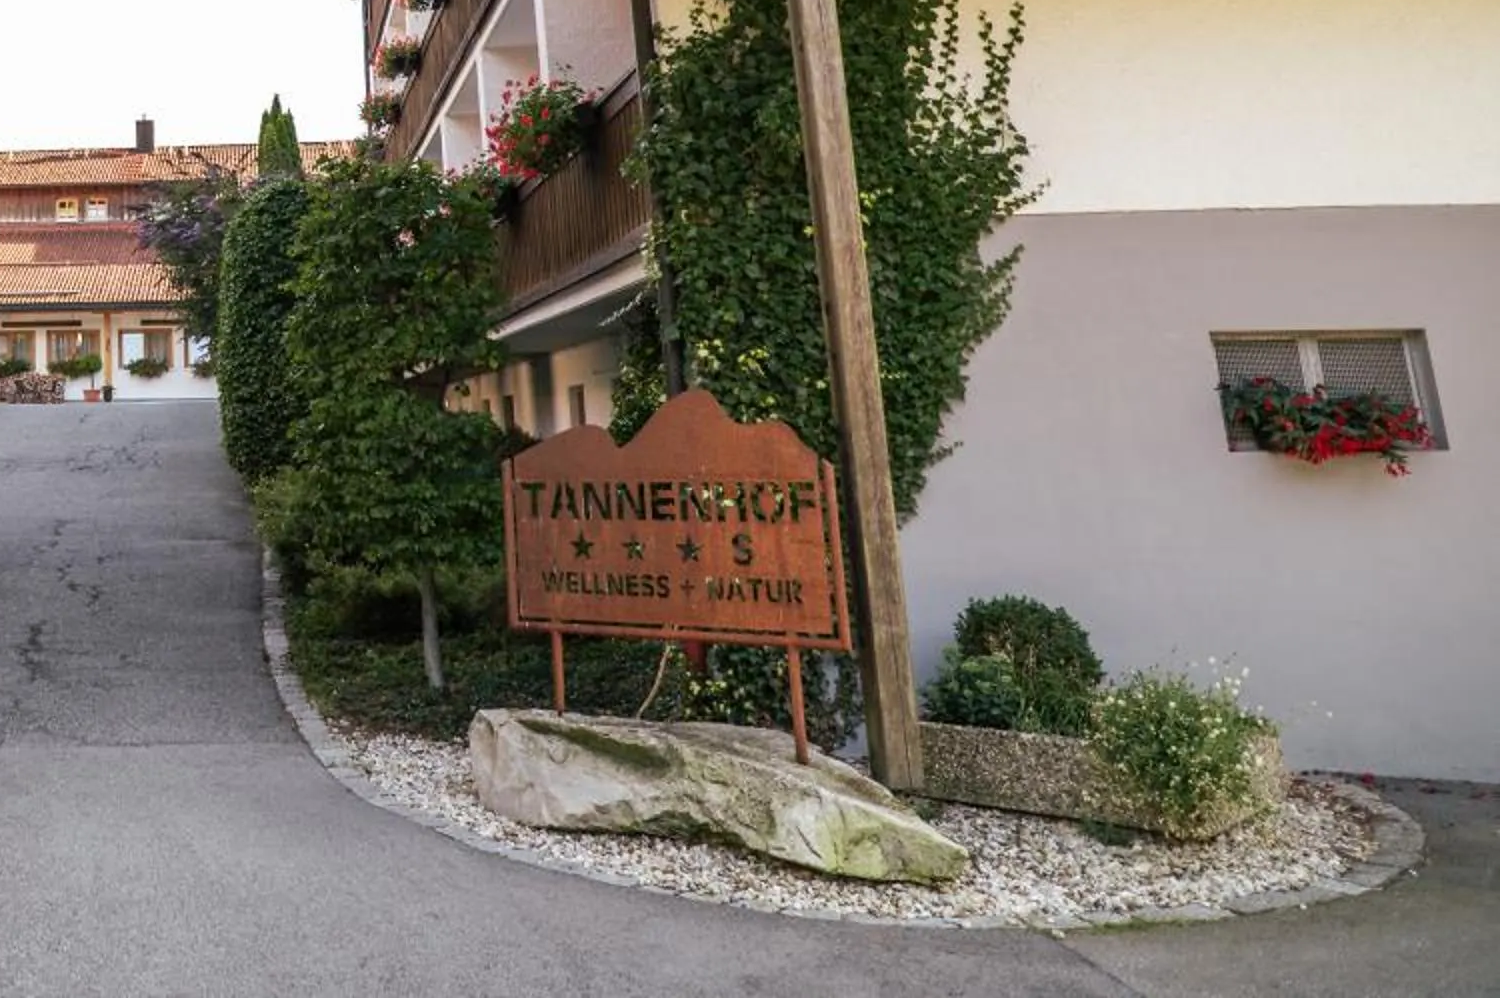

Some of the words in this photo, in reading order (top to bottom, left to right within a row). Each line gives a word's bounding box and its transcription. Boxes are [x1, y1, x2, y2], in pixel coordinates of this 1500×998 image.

[520, 481, 818, 524] TANNENHOF
[731, 533, 755, 566] S
[541, 570, 671, 599] WELLNESS
[706, 576, 804, 605] NATUR
